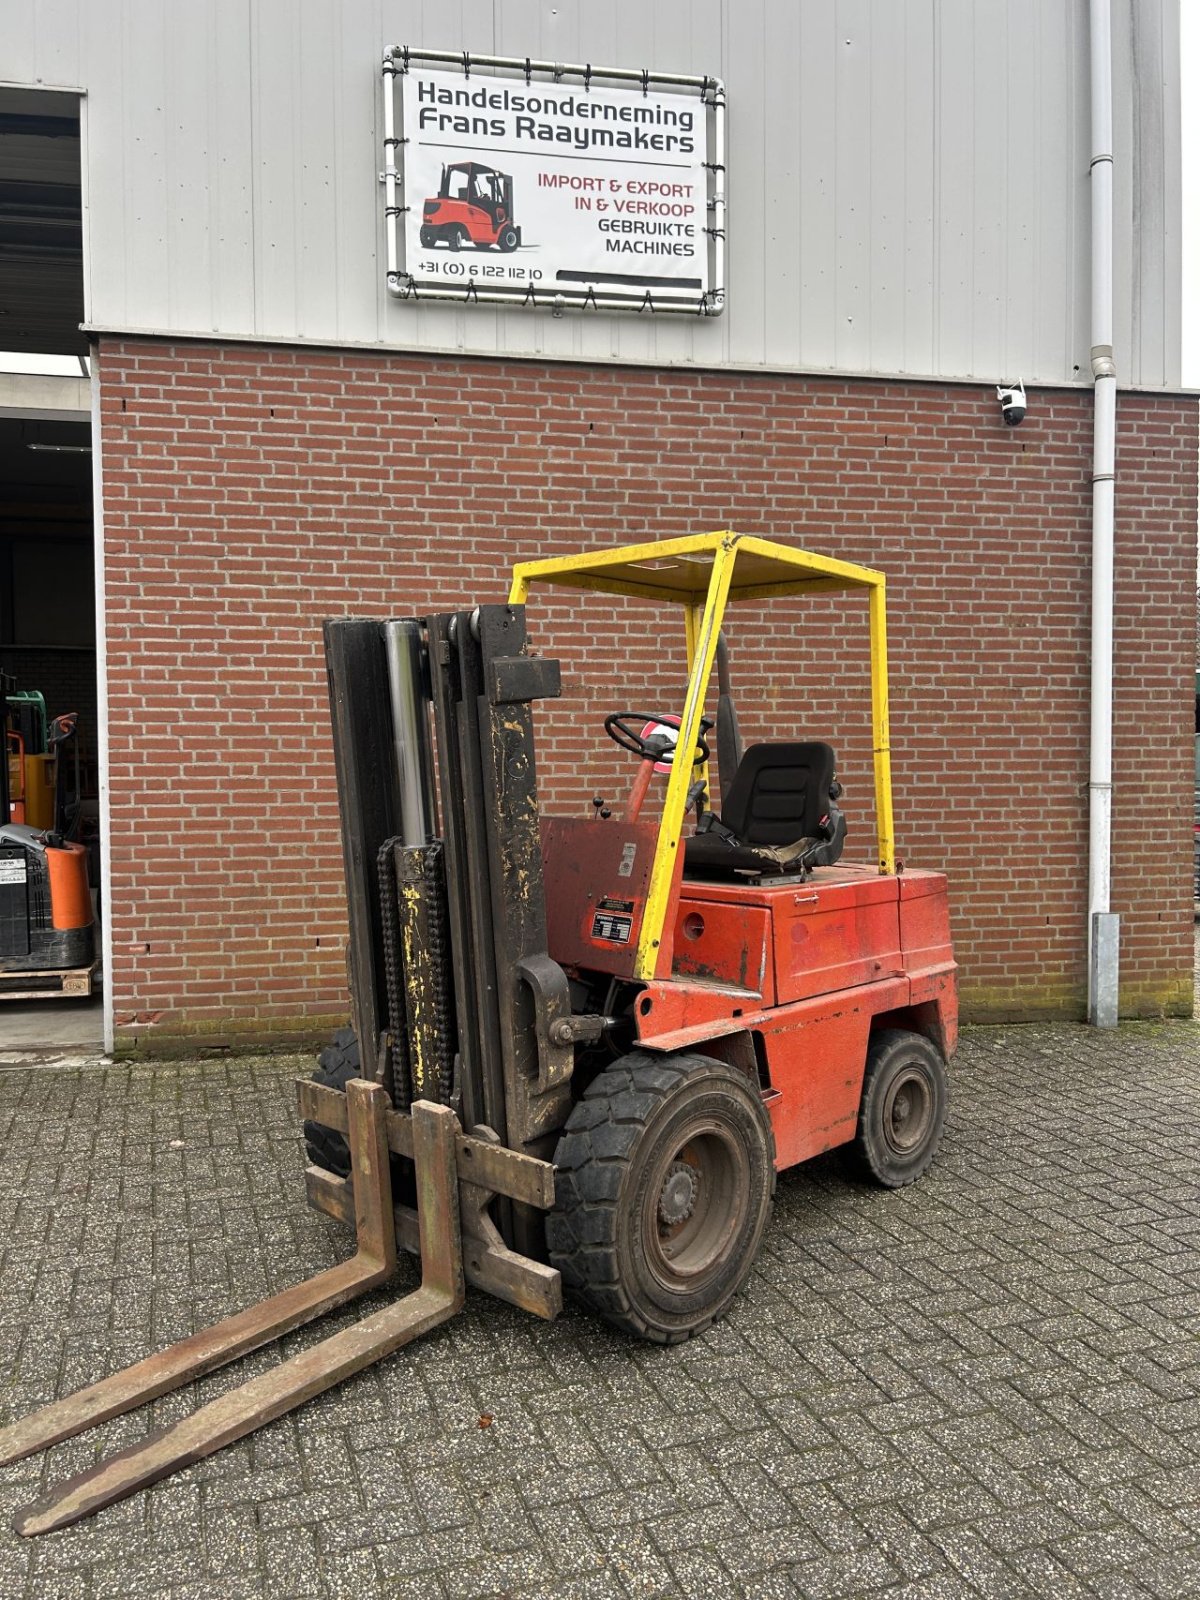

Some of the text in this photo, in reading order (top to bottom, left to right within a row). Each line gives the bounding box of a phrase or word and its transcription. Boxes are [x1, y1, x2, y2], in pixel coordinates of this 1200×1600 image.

[418, 81, 693, 131] Handelsonderneming
[419, 107, 694, 153] Frans Raaymakers
[538, 173, 693, 198] IMPORT & EXPORT
[575, 196, 695, 217] IN & VERKOOP
[598, 218, 695, 237] GEBRUIKTE
[606, 239, 695, 257] MACHINES
[418, 262, 542, 280] +31 (0) 6 122 112 10
